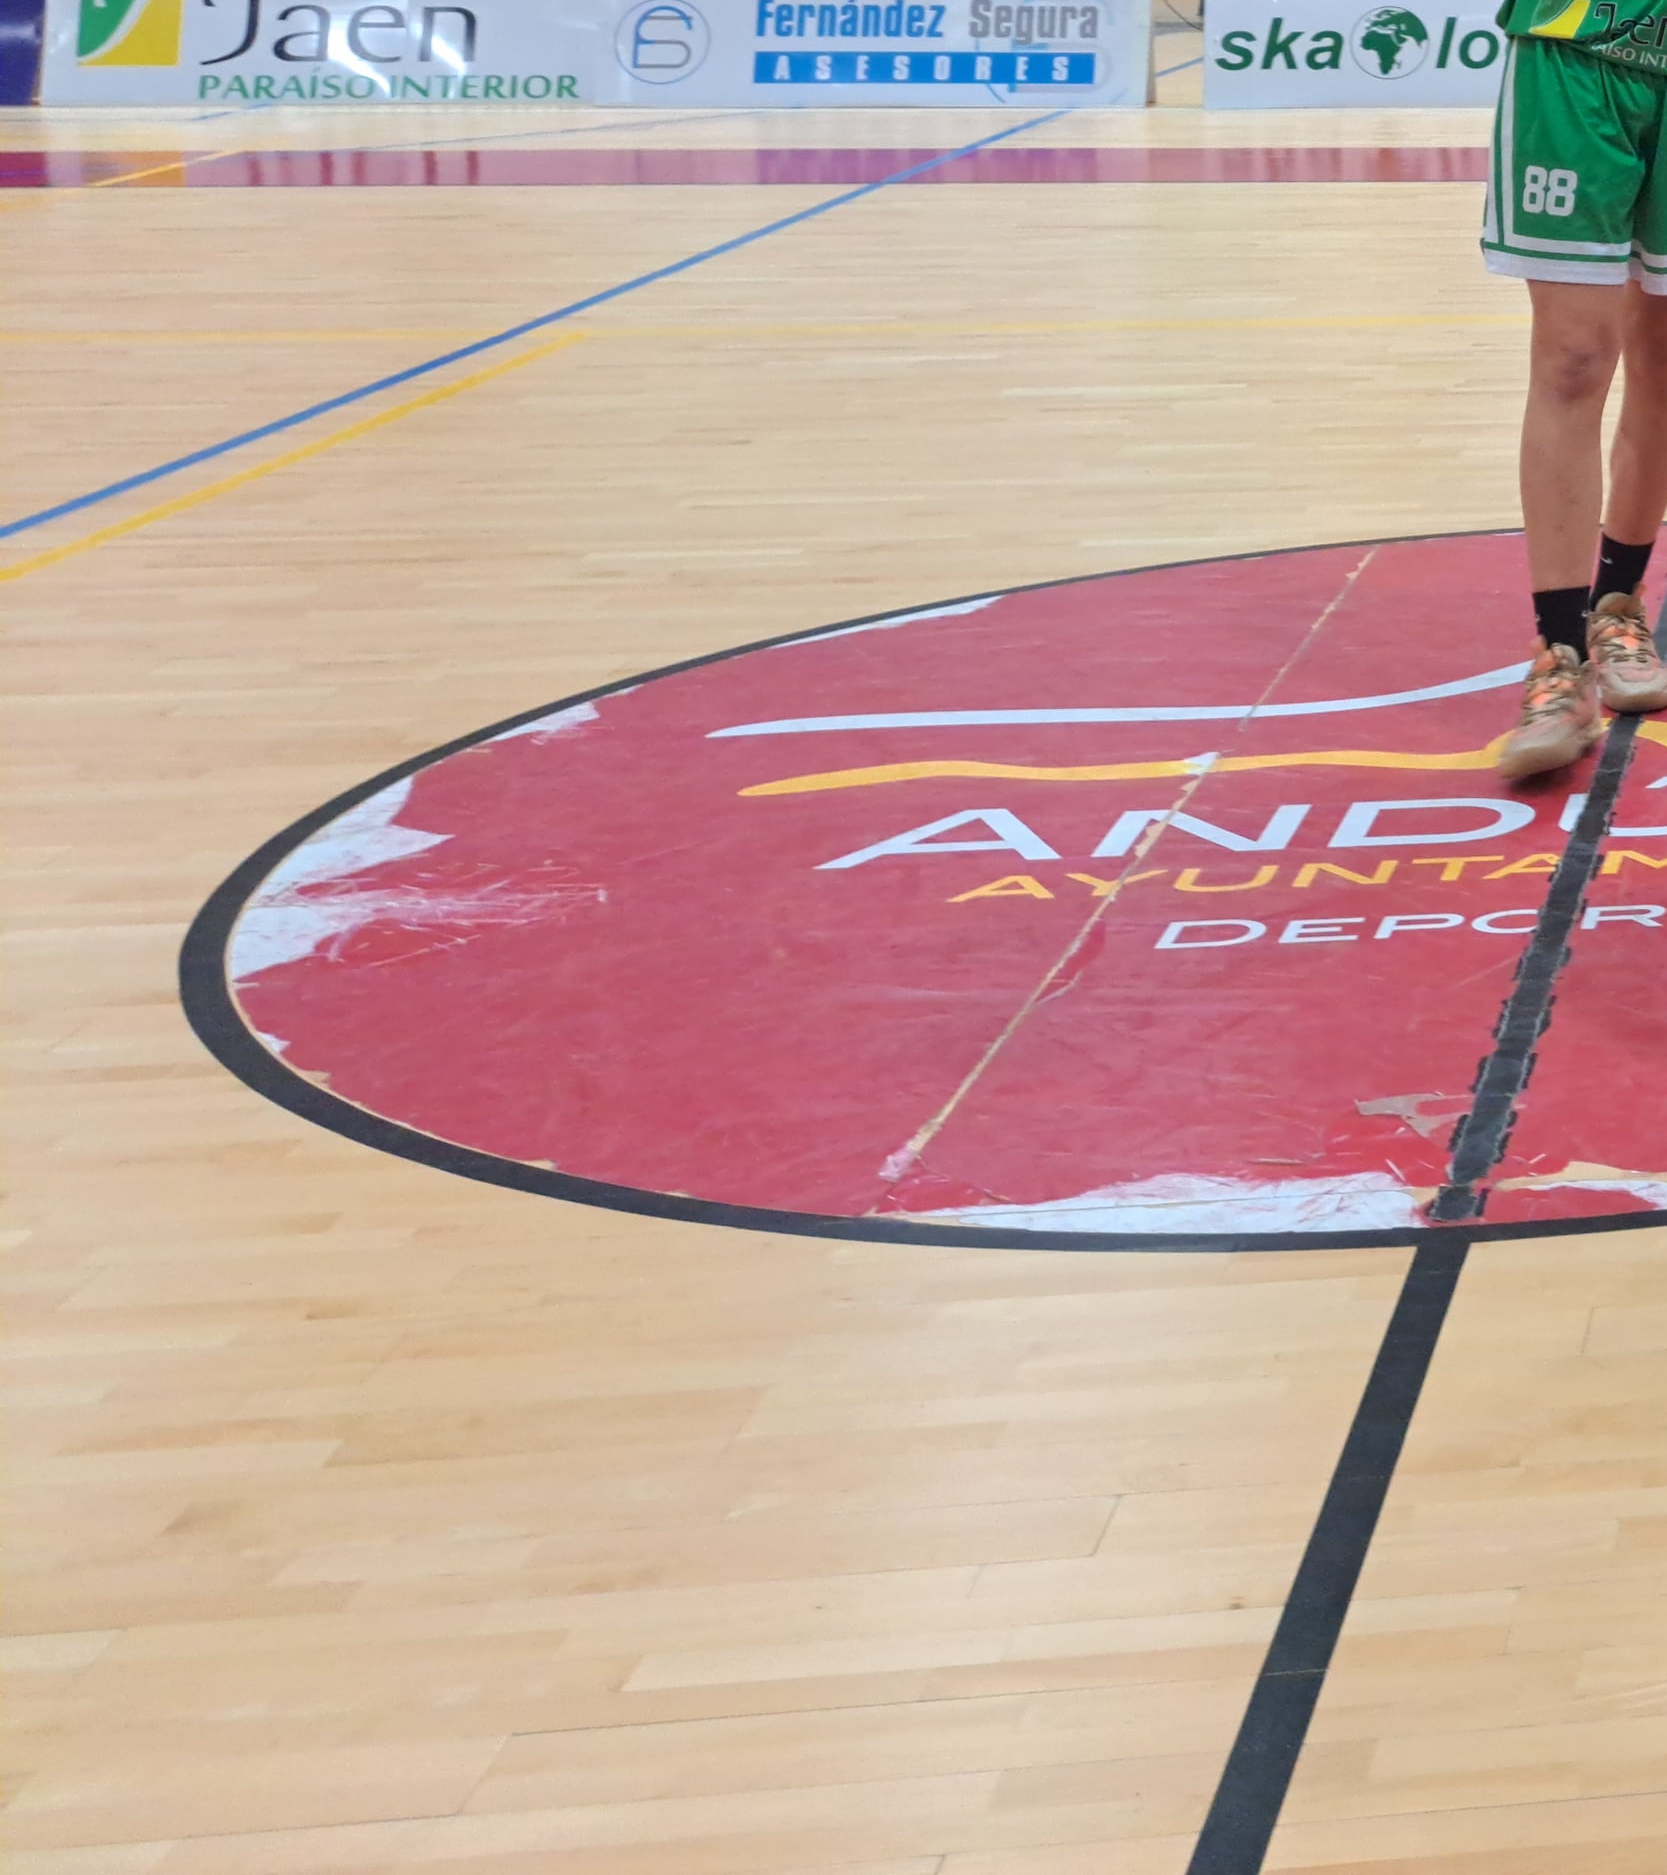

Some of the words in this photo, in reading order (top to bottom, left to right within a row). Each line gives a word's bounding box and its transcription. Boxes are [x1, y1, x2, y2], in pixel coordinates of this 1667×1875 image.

[199, 67, 375, 100] PARAÍSO
[390, 73, 580, 99] INTERIOR
[772, 54, 1091, 82] ASESORES
[1522, 164, 1578, 217] 88
